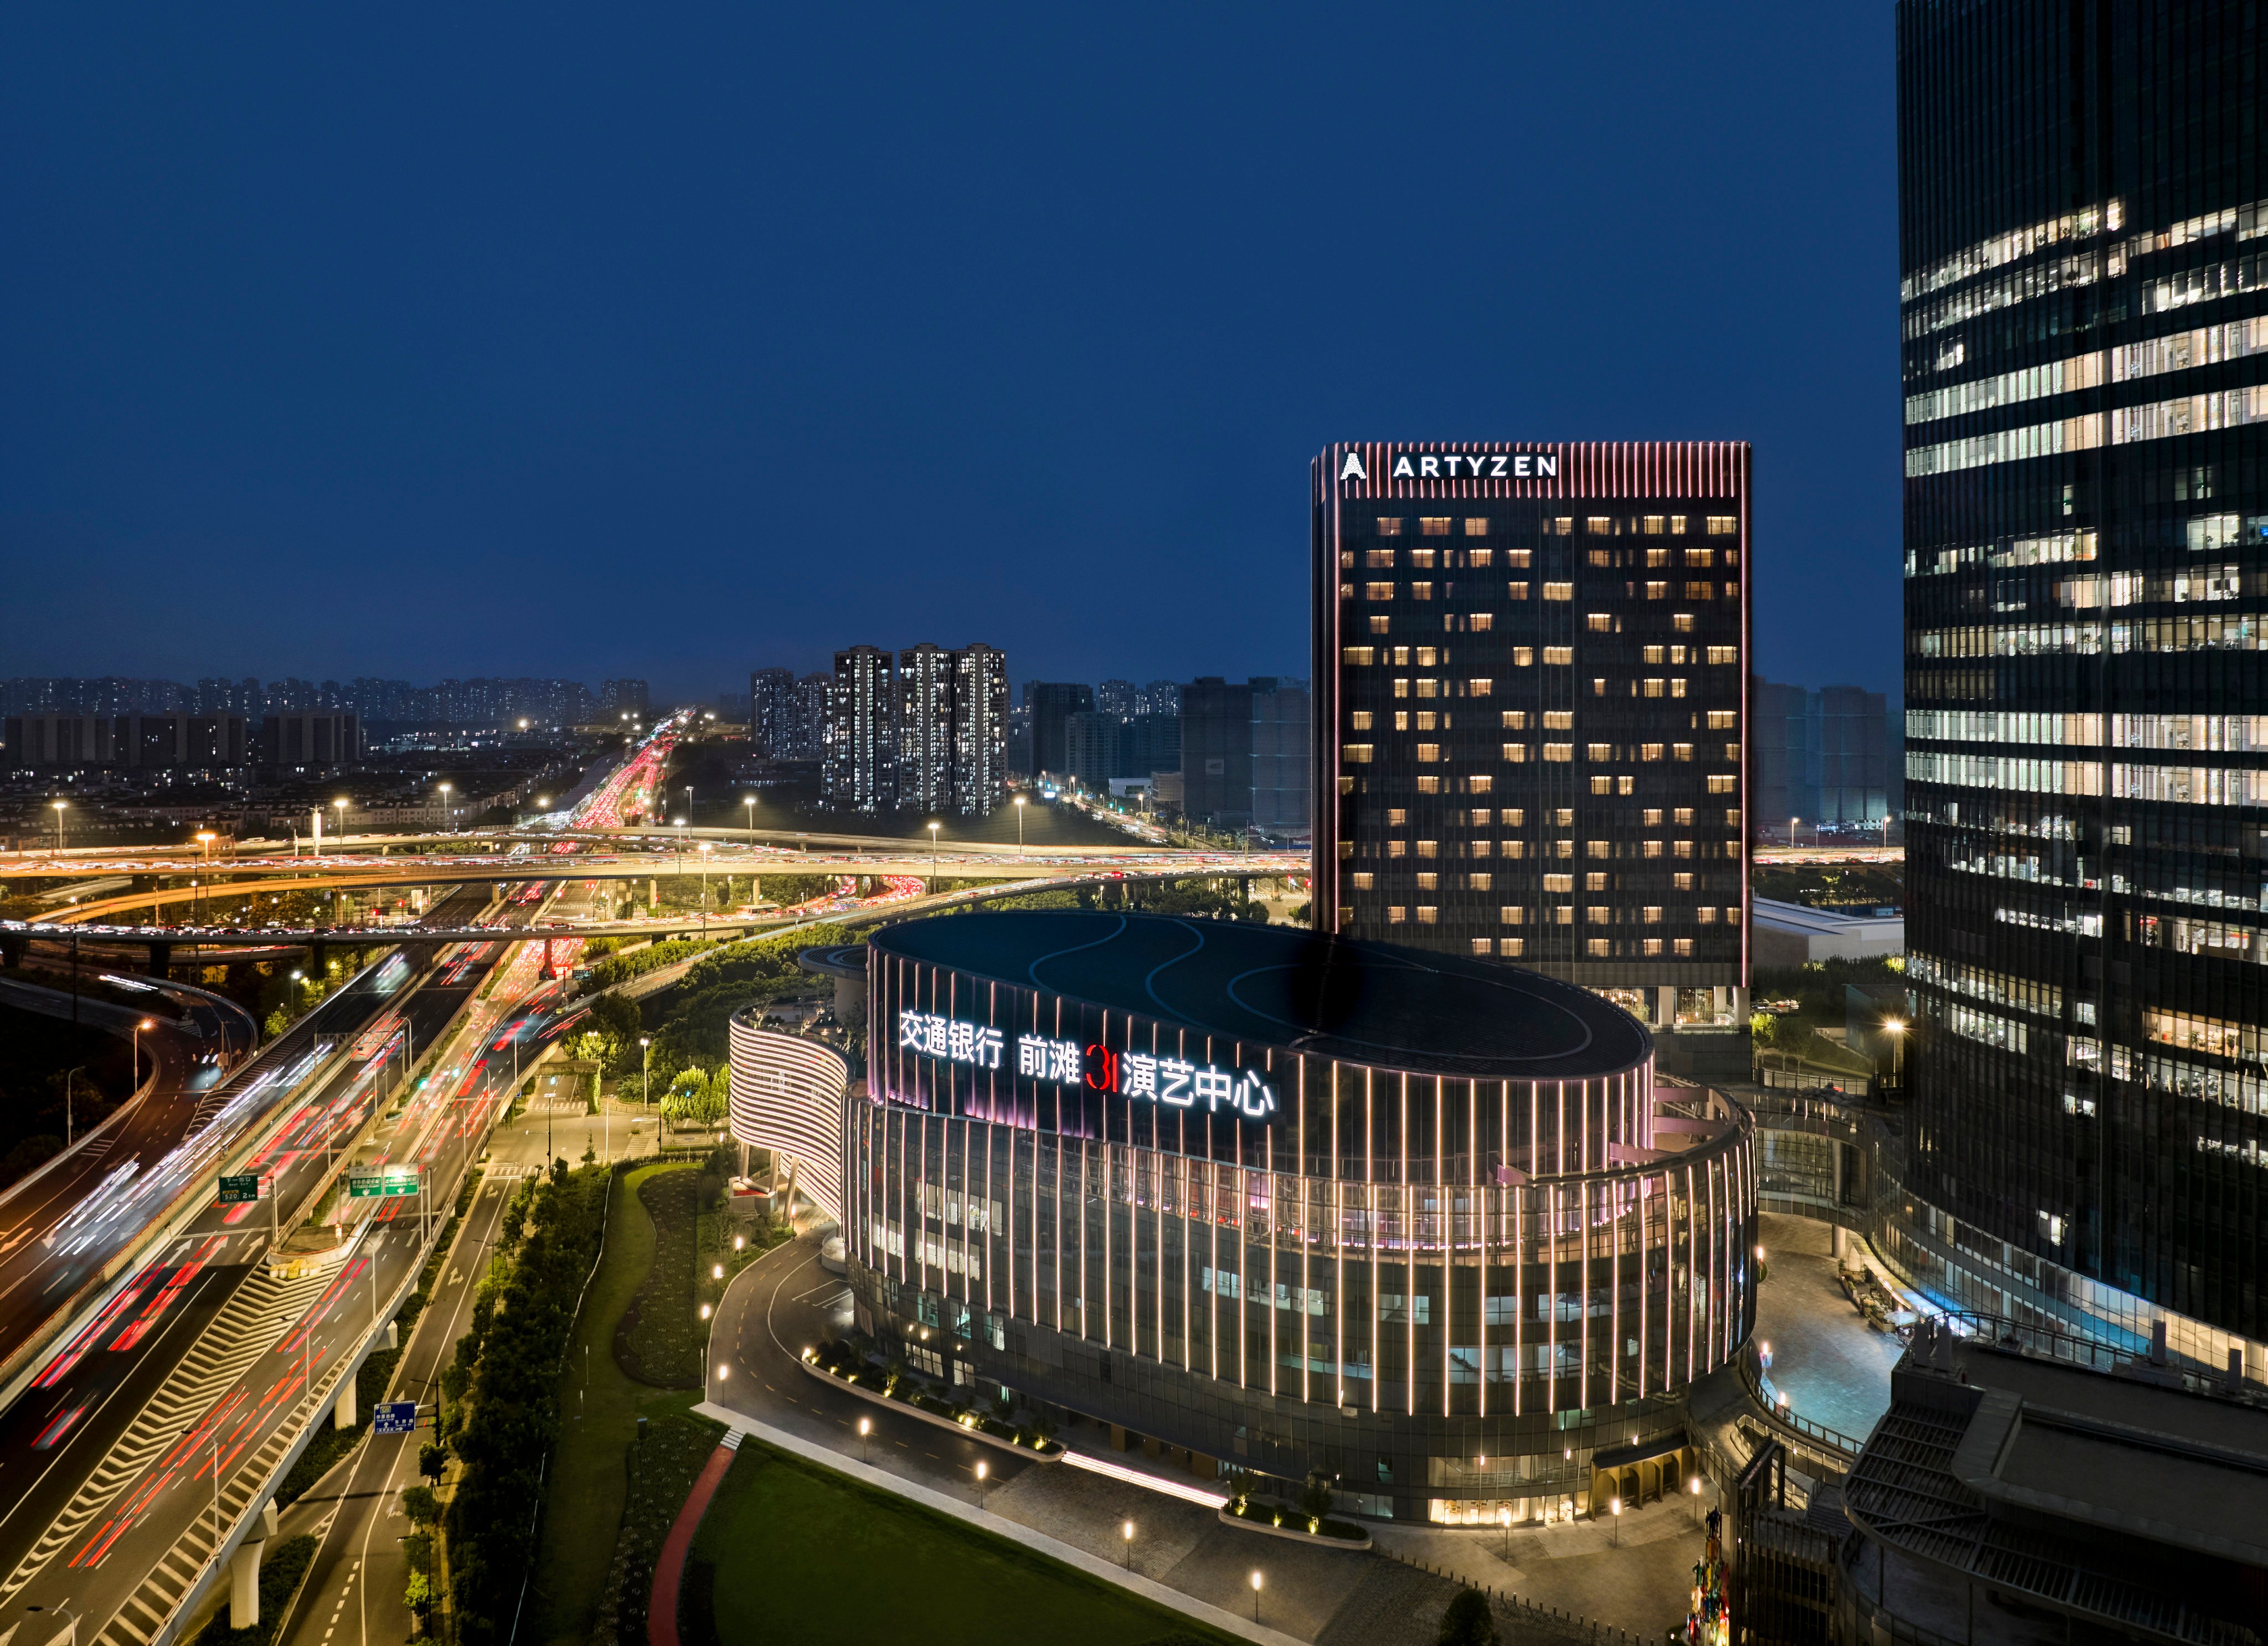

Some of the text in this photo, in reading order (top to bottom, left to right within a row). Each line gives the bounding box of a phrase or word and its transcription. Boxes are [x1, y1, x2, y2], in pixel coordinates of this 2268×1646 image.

[1393, 456, 1556, 477] ARTYZEN
[900, 1009, 1004, 1069] 交通银行
